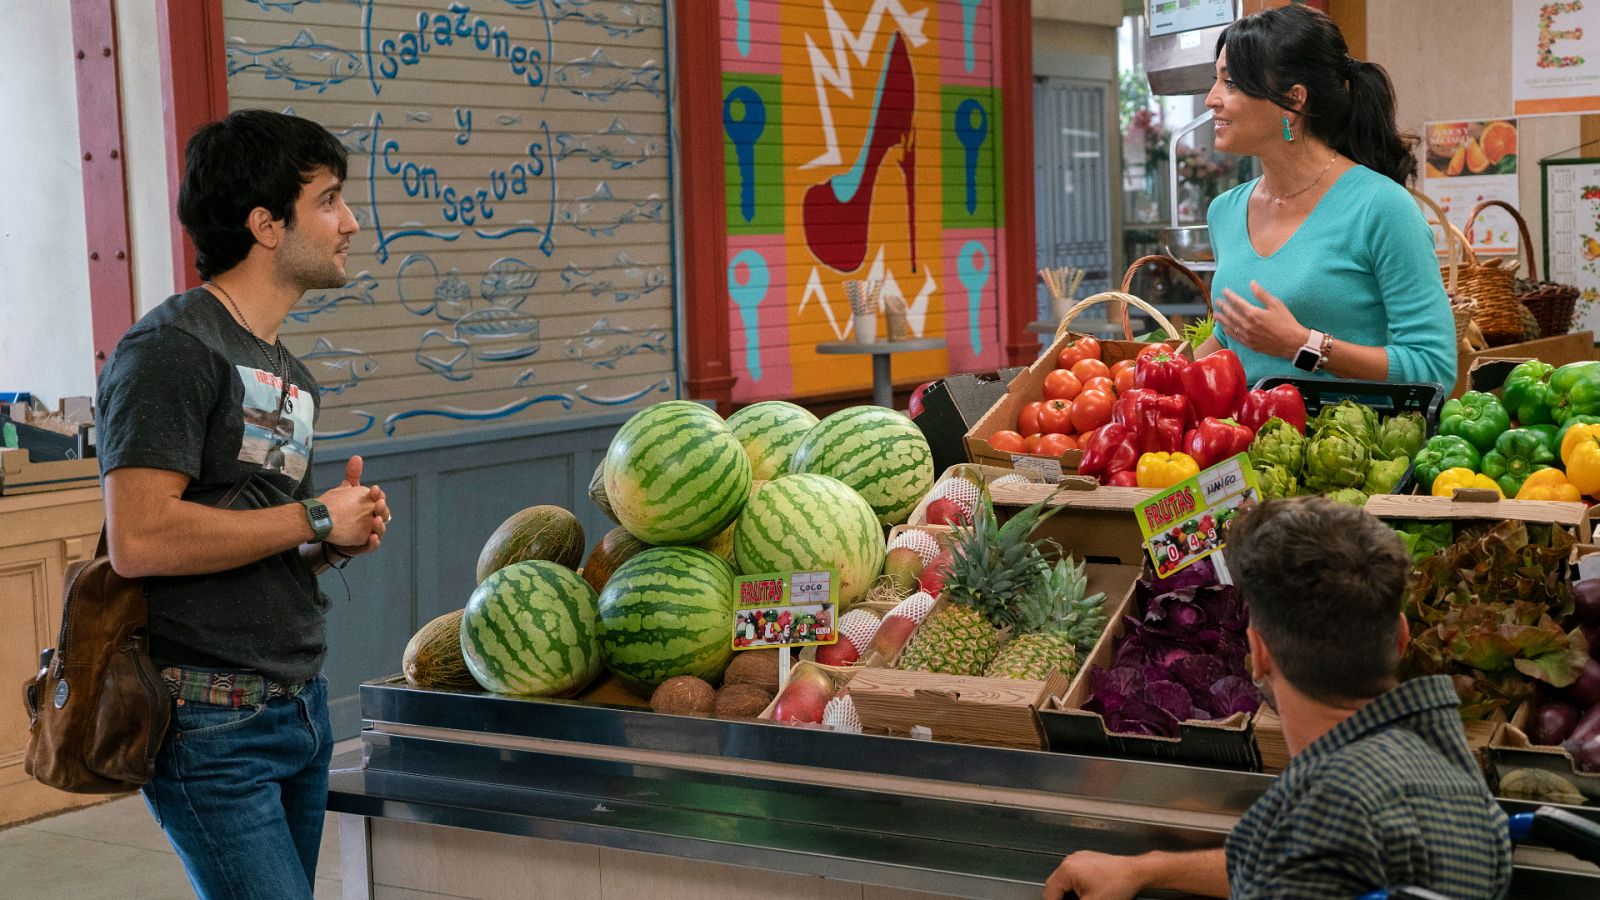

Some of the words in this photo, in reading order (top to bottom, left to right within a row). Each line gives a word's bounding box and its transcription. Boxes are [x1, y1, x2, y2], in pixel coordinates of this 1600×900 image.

[1207, 474, 1236, 495] MANGO
[1144, 486, 1195, 529] FRUTAS
[740, 579, 782, 604] FRUTAS
[799, 583, 822, 592] COCO
